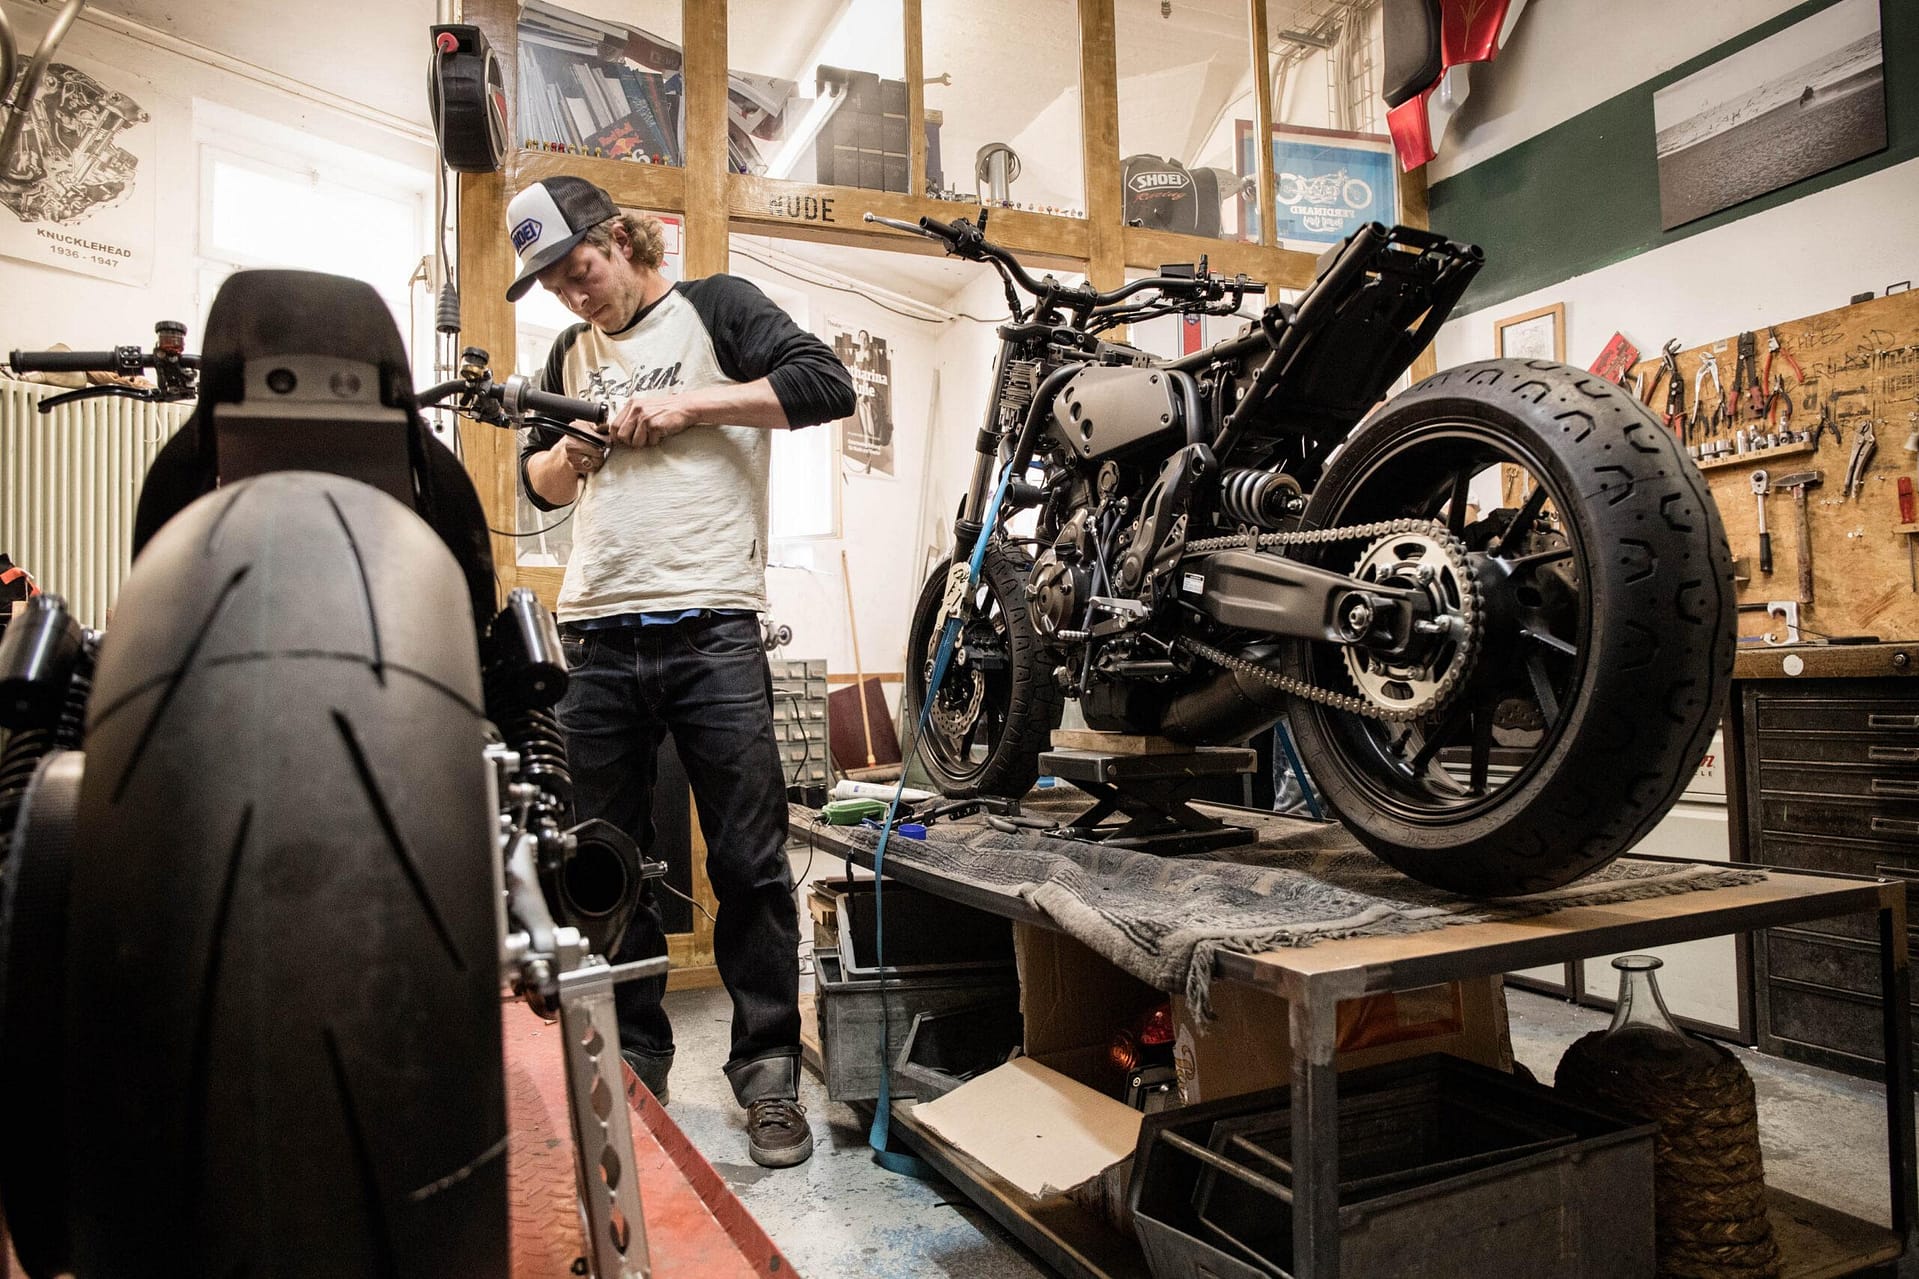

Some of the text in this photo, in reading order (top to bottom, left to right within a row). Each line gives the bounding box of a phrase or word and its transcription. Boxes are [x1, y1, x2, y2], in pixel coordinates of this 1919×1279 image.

[1136, 173, 1182, 189] SHOEI
[36, 228, 132, 258] KNUCKLEHEAD
[50, 245, 80, 259] 1936
[90, 255, 119, 268] 1947
[847, 365, 888, 386] atharina
